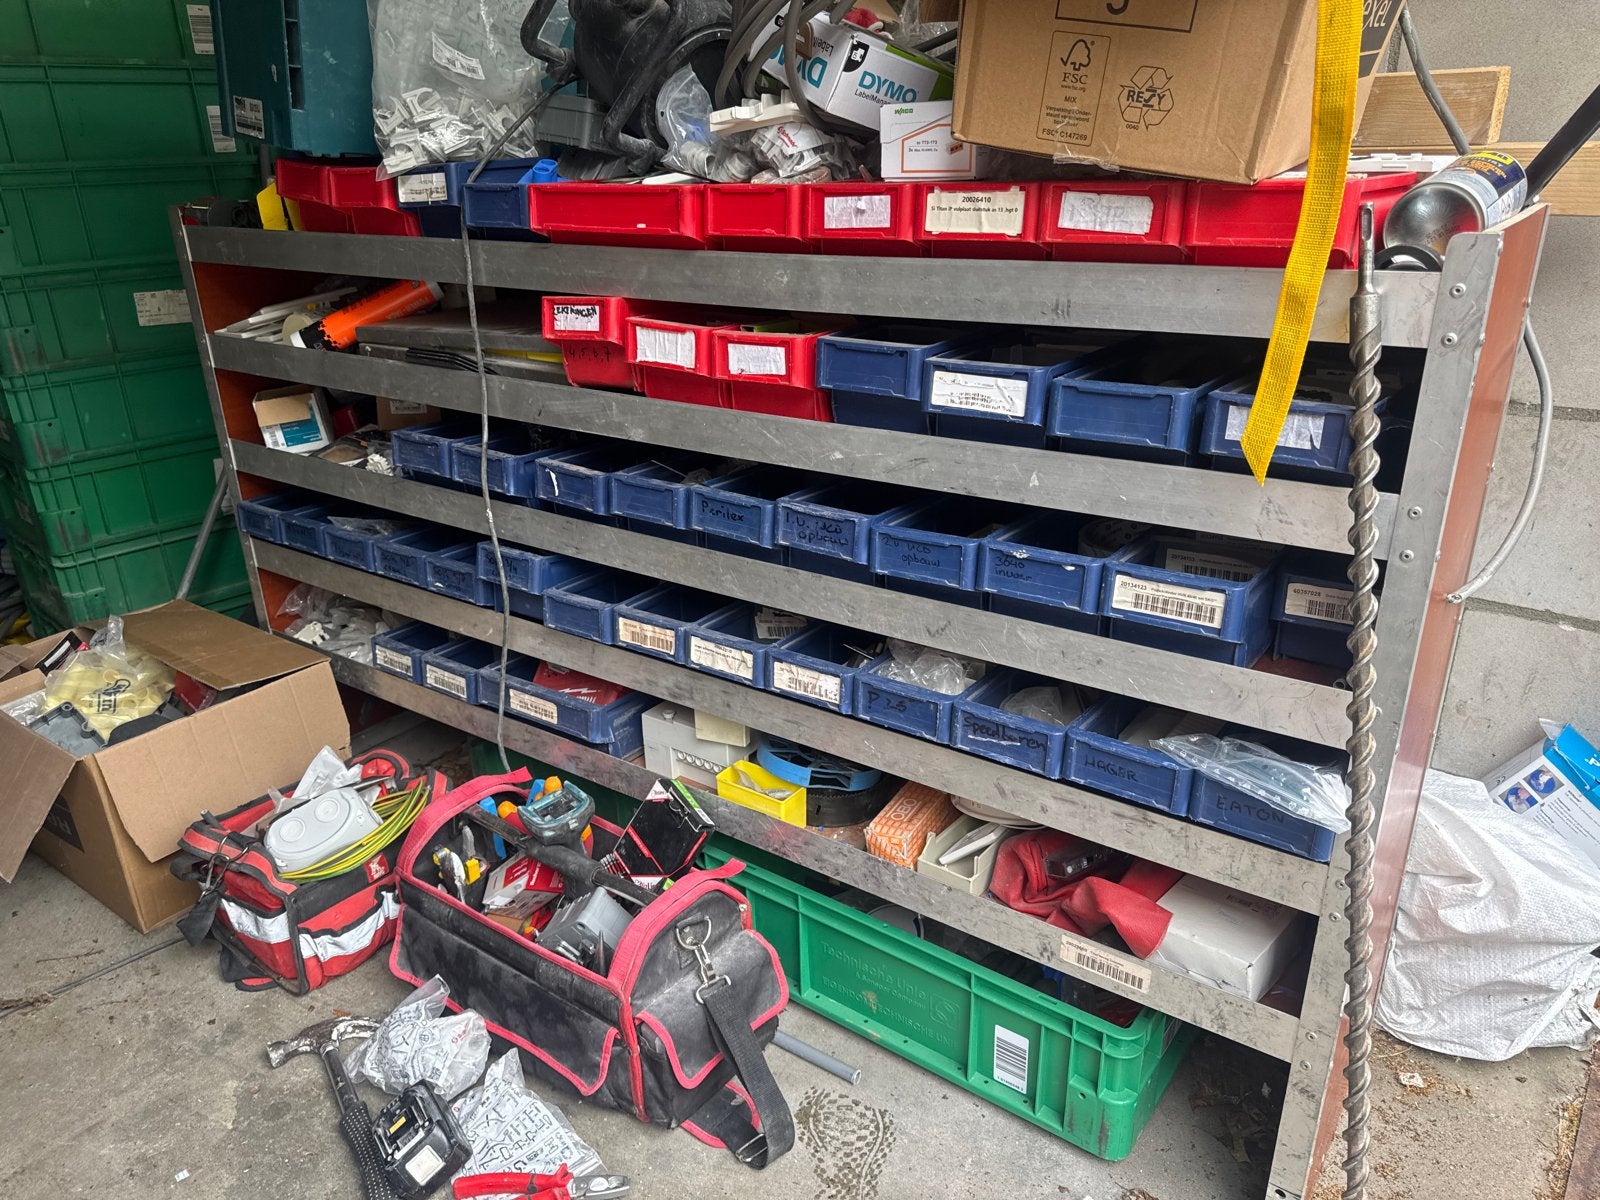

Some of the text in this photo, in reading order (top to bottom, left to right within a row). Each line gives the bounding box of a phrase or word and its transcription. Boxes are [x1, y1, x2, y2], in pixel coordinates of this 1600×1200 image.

[1062, 72, 1089, 85] FSC
[858, 70, 917, 104] DYMO
[1064, 96, 1078, 104] MIX
[1059, 130, 1088, 142] C147269
[961, 195, 992, 204] 20026410
[1120, 581, 1148, 591] 20134123
[1084, 754, 1138, 783] HAGER
[890, 798, 918, 821] OBO
[1216, 794, 1285, 824] EATON
